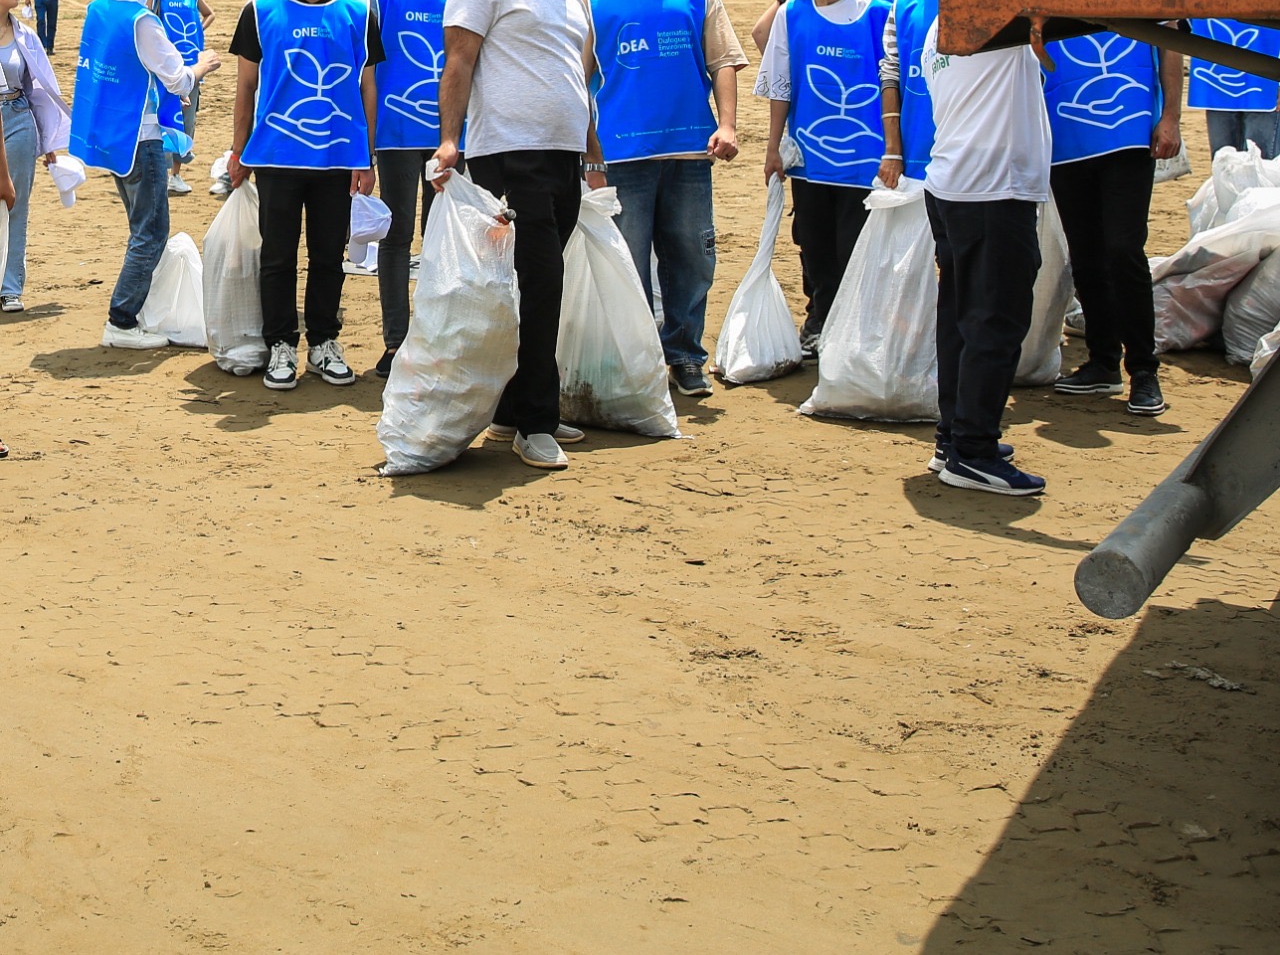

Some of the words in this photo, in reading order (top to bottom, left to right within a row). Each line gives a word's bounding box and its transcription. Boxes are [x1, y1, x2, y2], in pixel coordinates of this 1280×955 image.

[405, 11, 429, 23] ONE
[292, 26, 318, 38] ONE
[816, 45, 843, 58] ONE
